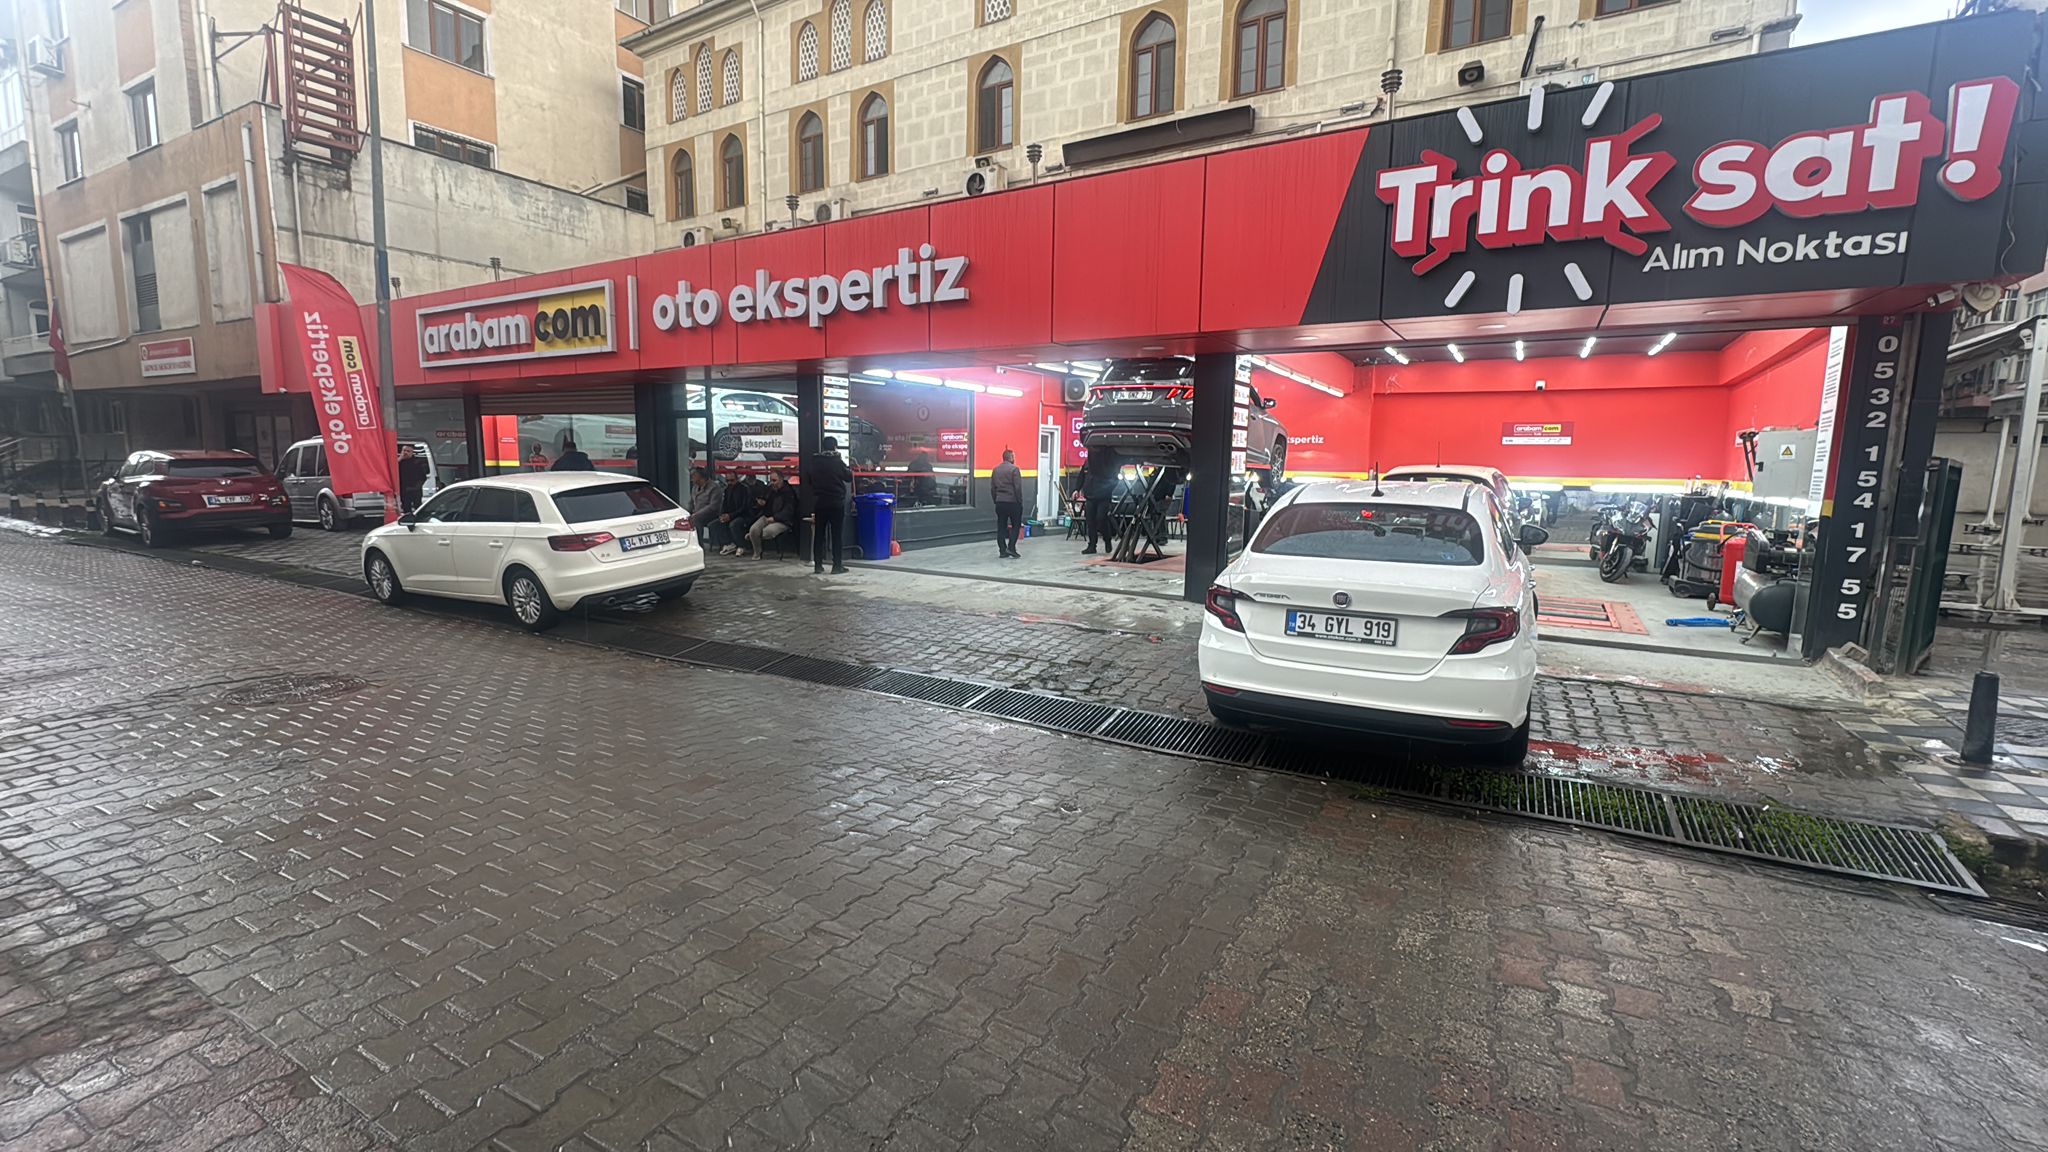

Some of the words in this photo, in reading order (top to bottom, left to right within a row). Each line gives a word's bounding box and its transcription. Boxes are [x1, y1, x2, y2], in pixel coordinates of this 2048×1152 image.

[1376, 136, 1660, 250] Trink
[1642, 243, 1724, 272] Alım
[1736, 230, 1909, 265] Noktası
[652, 280, 721, 331] oto
[729, 243, 970, 328] ekspertiz
[424, 312, 531, 354] arabam
[534, 304, 605, 343] com
[626, 538, 636, 547] 34
[1297, 614, 1316, 631] 34
[1325, 616, 1354, 635] GYL
[1364, 620, 1392, 639] 919
